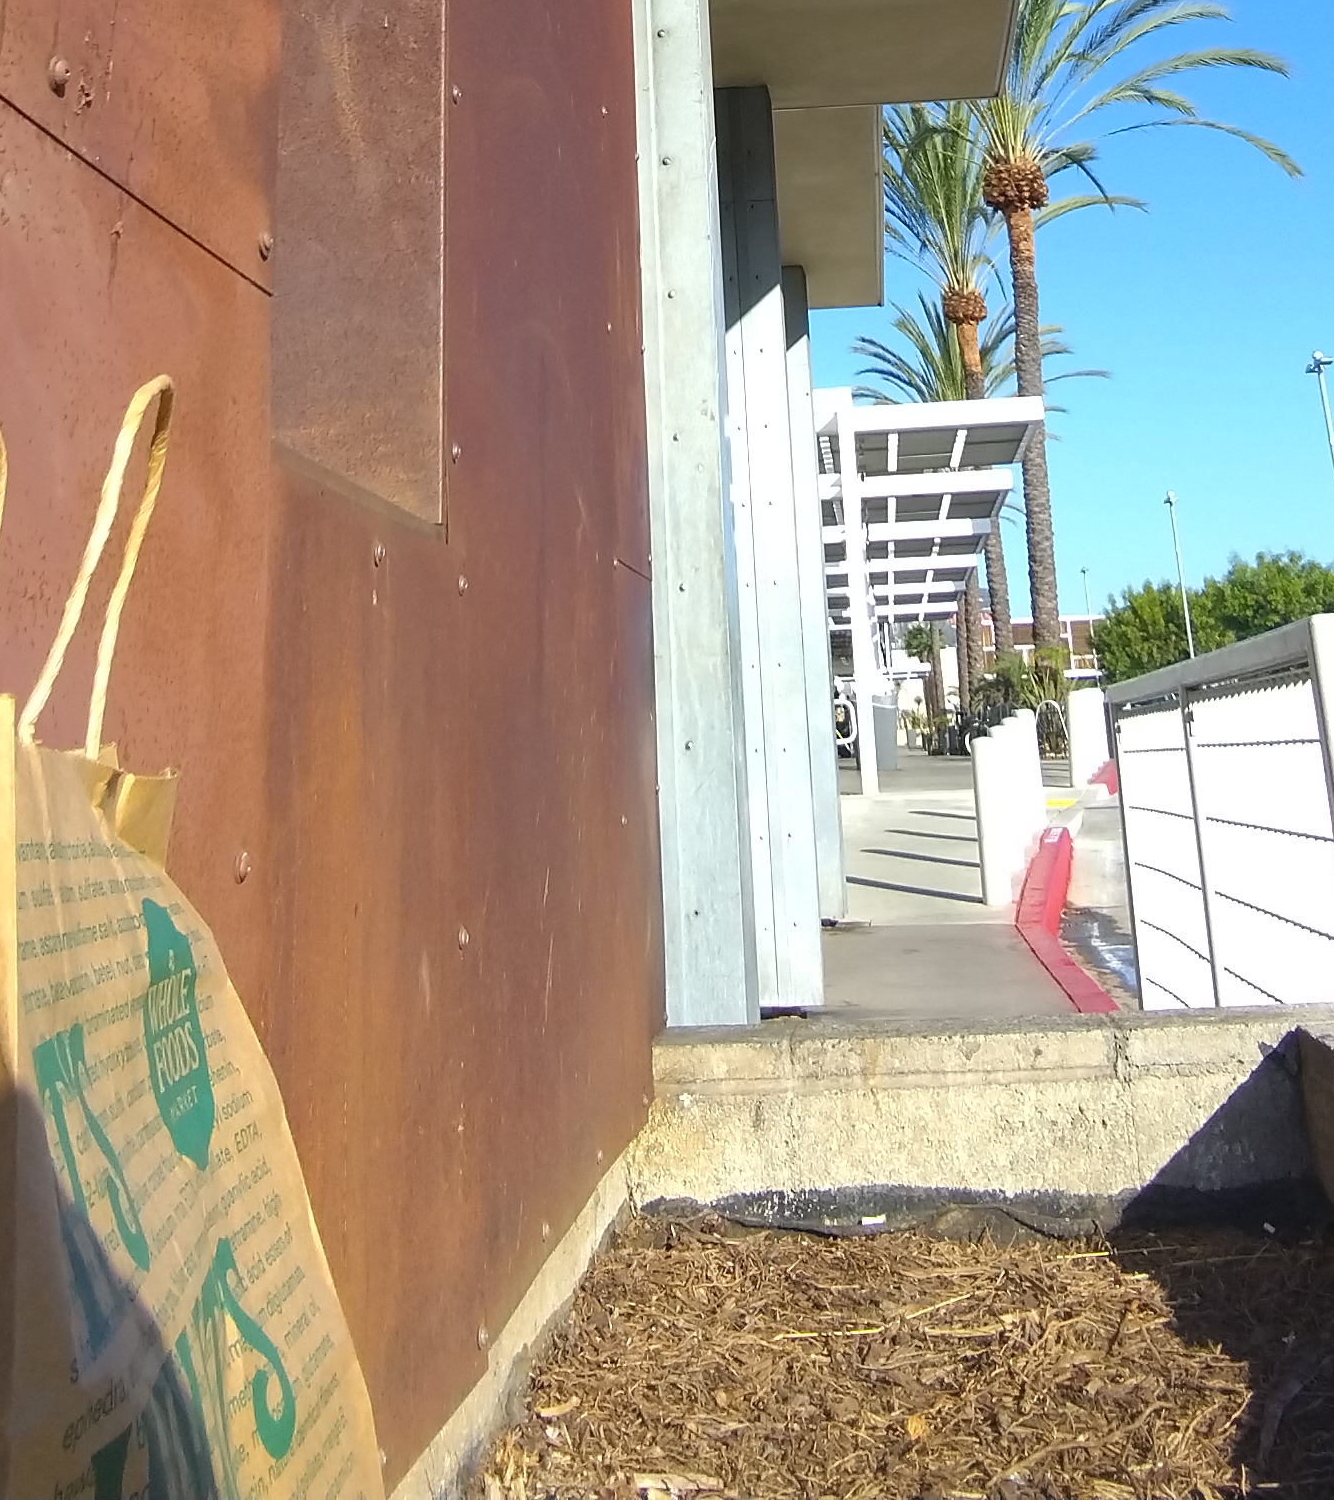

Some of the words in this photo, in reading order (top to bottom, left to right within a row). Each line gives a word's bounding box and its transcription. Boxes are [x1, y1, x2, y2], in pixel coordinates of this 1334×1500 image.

[147, 968, 192, 1035] WHOLE
[153, 1021, 199, 1094] FOODS
[221, 1089, 254, 1121] sodium
